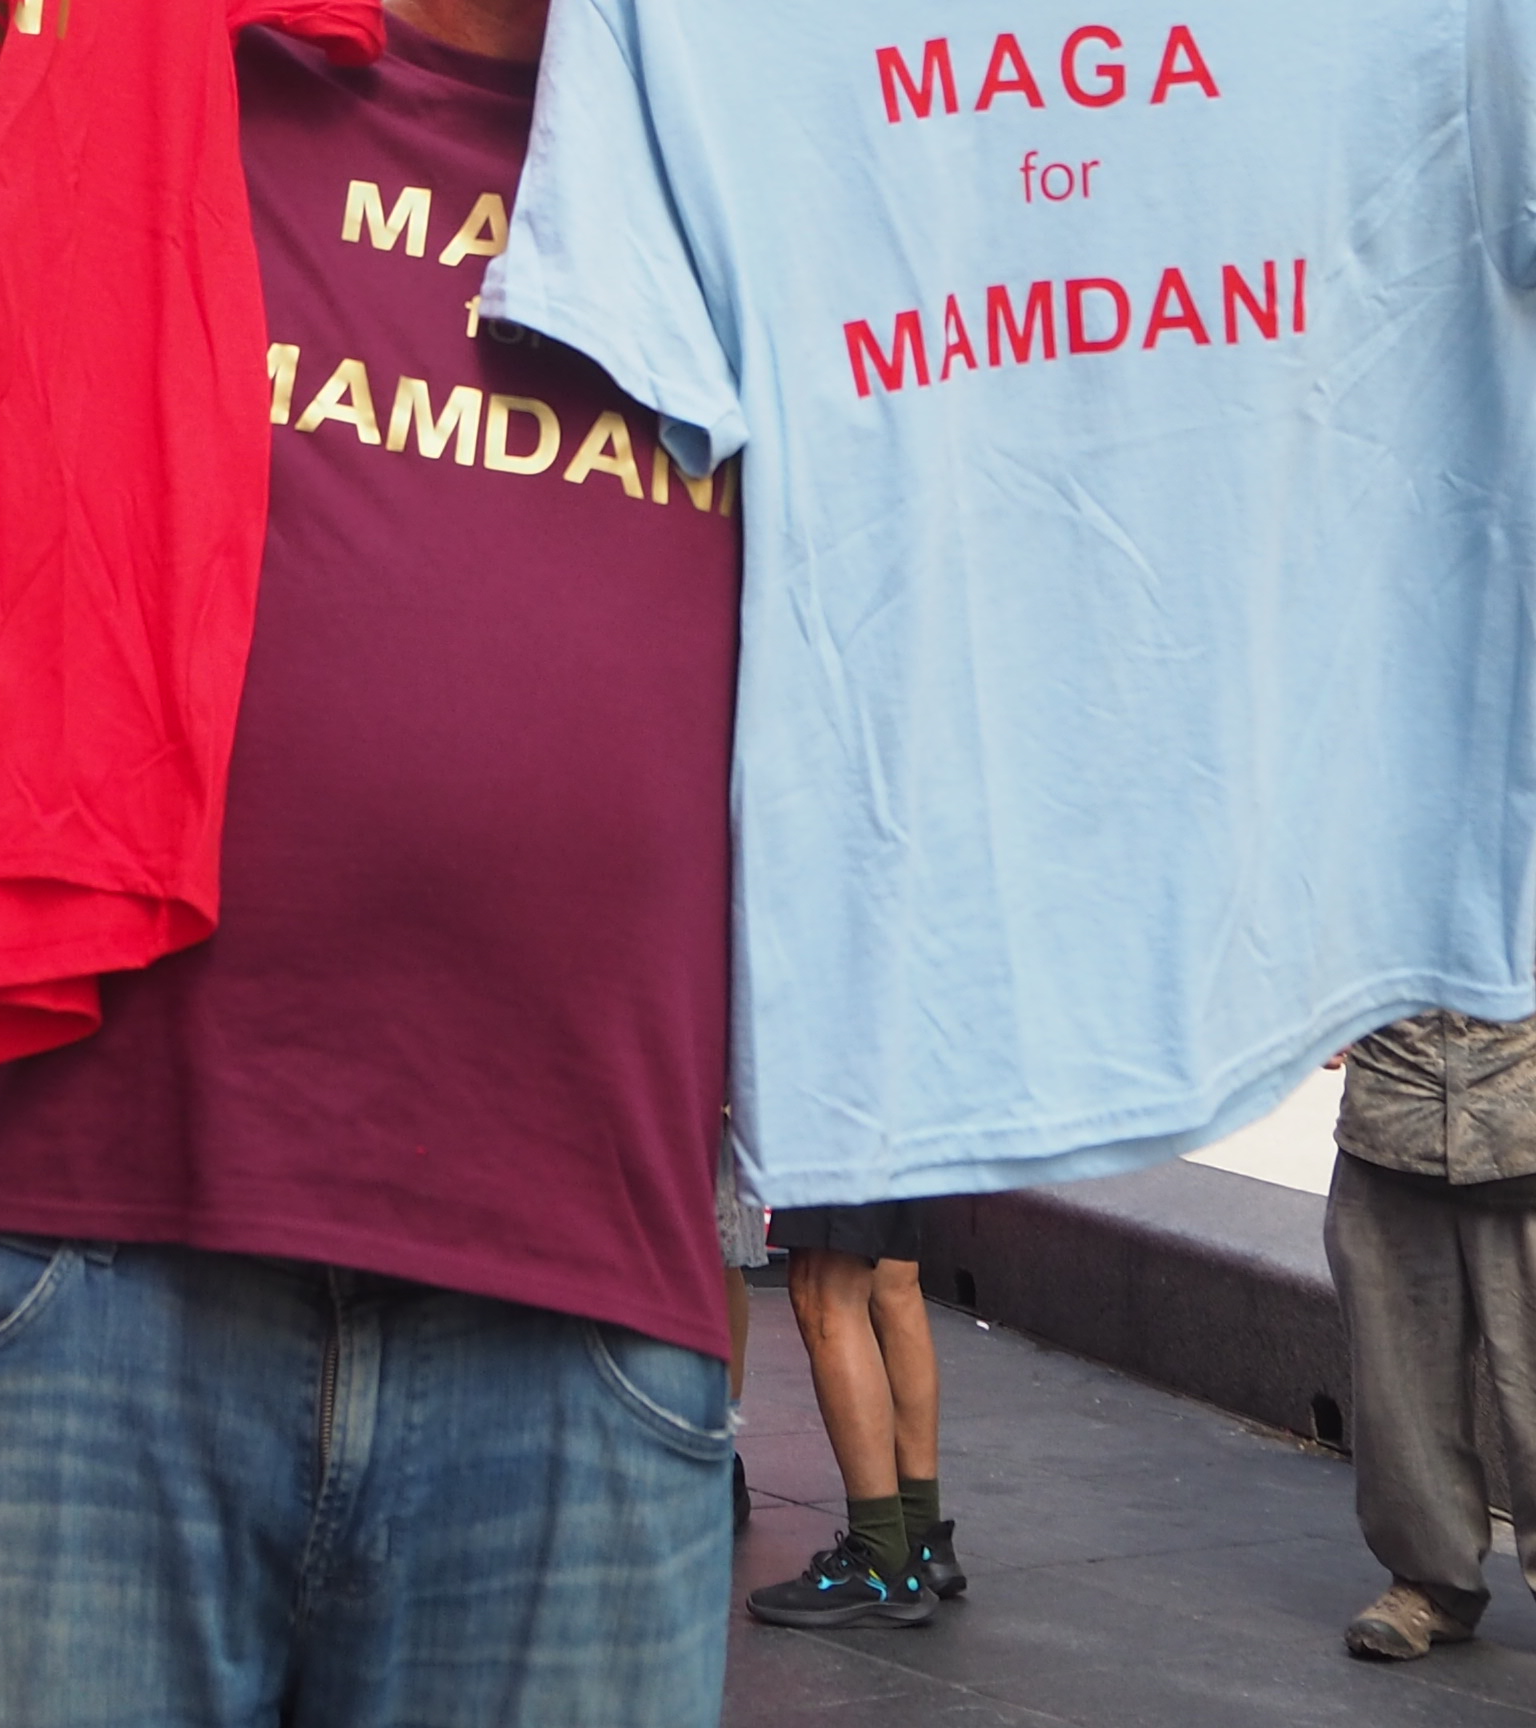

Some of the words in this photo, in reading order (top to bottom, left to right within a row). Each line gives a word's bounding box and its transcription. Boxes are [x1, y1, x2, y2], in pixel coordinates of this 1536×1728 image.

[875, 24, 1221, 125] MAGA
[340, 179, 510, 267] MA
[1019, 149, 1101, 204] for
[842, 257, 1307, 399] MAMDANI
